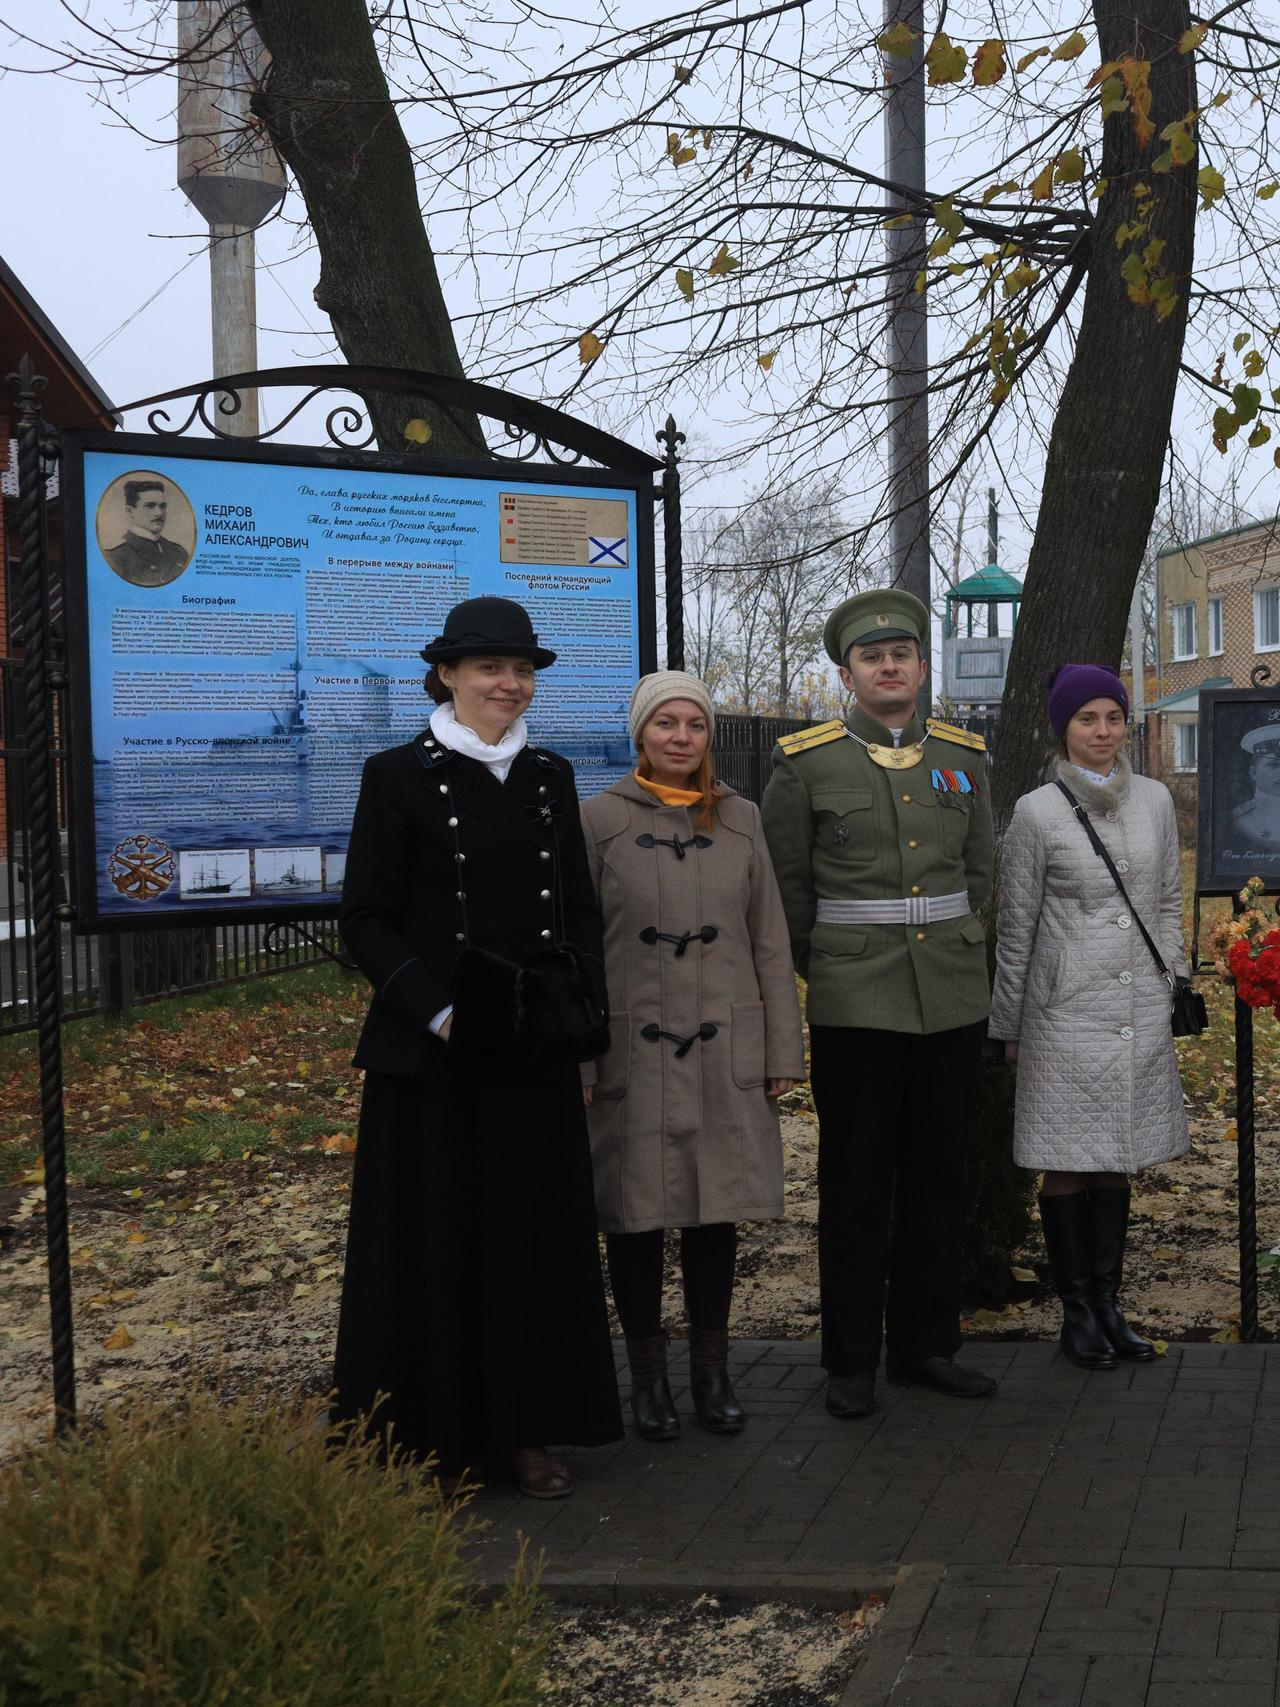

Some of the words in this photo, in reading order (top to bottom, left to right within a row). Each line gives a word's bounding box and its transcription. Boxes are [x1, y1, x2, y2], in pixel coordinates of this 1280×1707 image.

[298, 485, 318, 497] Да,
[320, 488, 349, 498] слава
[351, 490, 388, 501] русских
[390, 493, 430, 504] моряков
[432, 494, 486, 507] бессмертна,
[204, 504, 253, 518] КЕДРОВ
[331, 502, 341, 512] В
[343, 505, 386, 515] историю
[389, 505, 426, 517] вписали
[428, 510, 456, 518] имена
[204, 519, 256, 532] МИХАИЛ
[307, 514, 331, 525] Тех,
[334, 516, 353, 526] кто
[355, 517, 386, 528] любил
[388, 519, 425, 530] Россию
[427, 521, 480, 534] беззаветно,
[204, 533, 309, 549] АЛЕКСАНДРОВИЧ
[322, 529, 334, 539] И
[335, 531, 379, 542] отдавал
[379, 535, 391, 544] за
[393, 533, 431, 545] Родину
[433, 537, 466, 547] сердца.
[328, 557, 334, 565] В
[337, 559, 382, 569] перерыве
[384, 561, 413, 570] между
[416, 561, 454, 570] войнами
[505, 572, 552, 582] Последний
[553, 574, 612, 585] командующий
[528, 582, 560, 591] флотом
[561, 582, 590, 591] России
[181, 595, 236, 606] Биография
[314, 676, 351, 684] Участие
[362, 676, 396, 686] Первой
[122, 736, 163, 746] Участие
[166, 738, 172, 746] в
[175, 736, 259, 747] Русско-японской
[262, 736, 291, 746] войне
